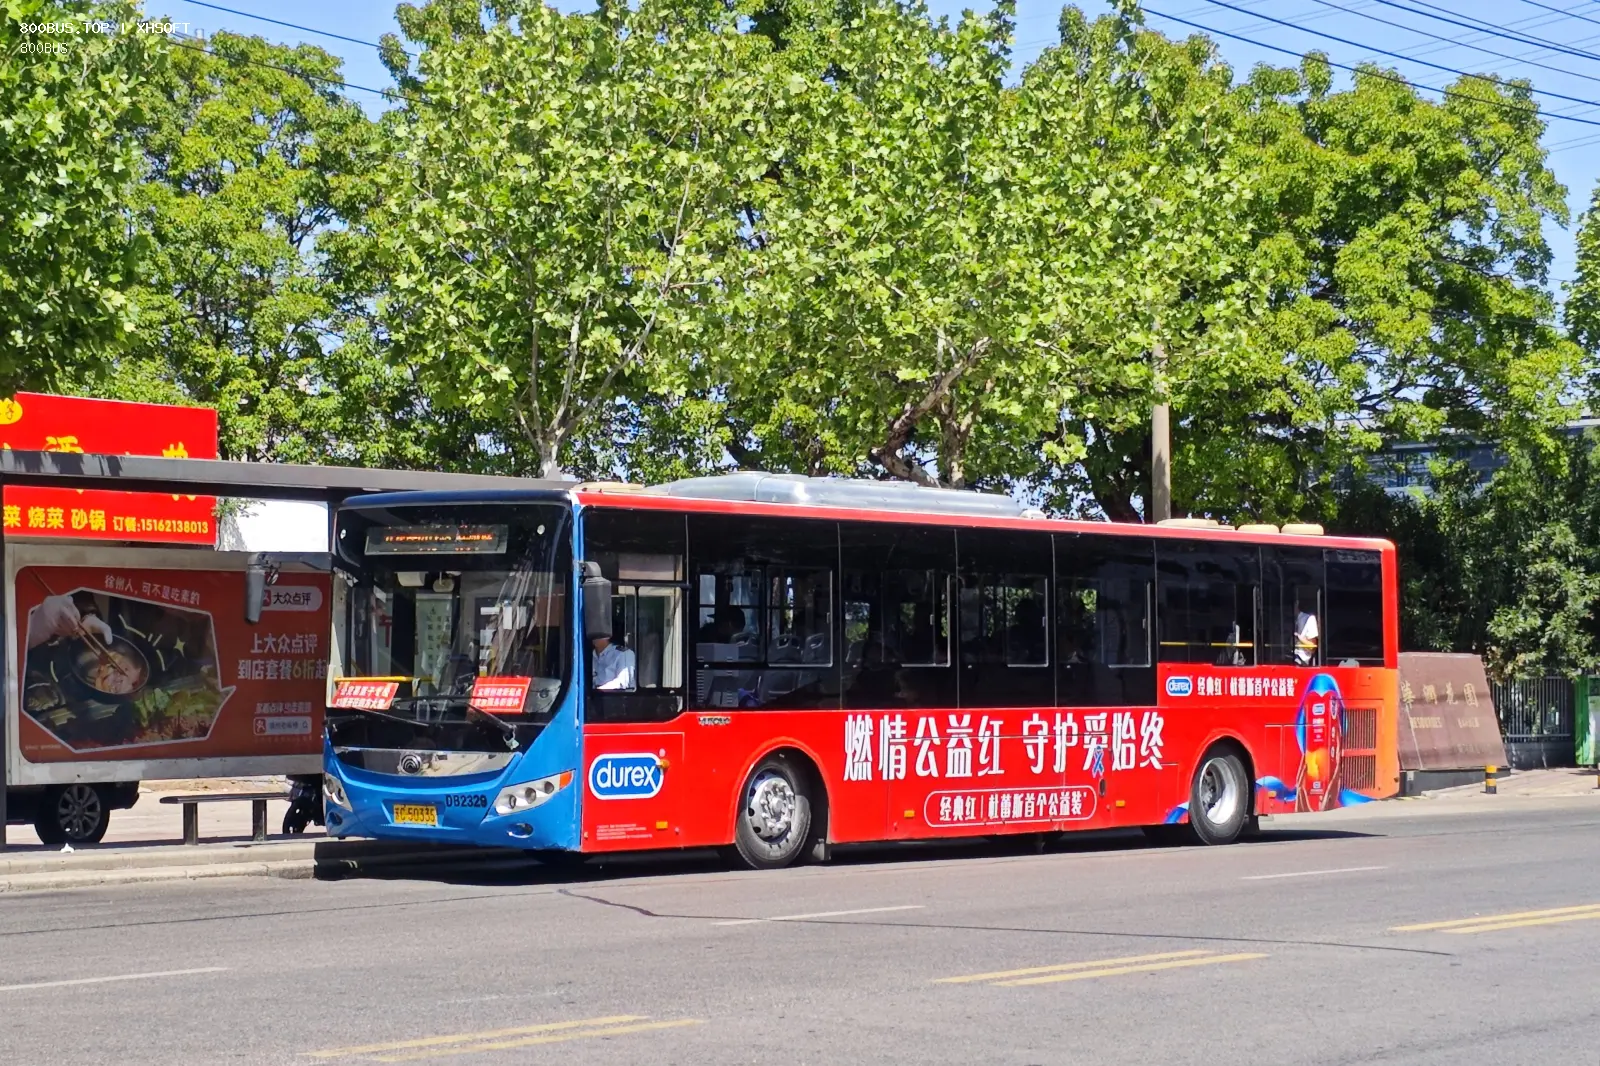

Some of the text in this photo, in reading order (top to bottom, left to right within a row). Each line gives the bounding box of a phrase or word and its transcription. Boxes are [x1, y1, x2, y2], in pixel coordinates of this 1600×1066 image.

[28, 506, 64, 530] 烧菜
[71, 508, 106, 531] 砂锅
[273, 592, 312, 606] 大众点评
[250, 632, 319, 654] 上大众点评
[237, 659, 328, 680] 到店套餐6折起
[843, 711, 1165, 782] 燃情公益红 守护爱始终
[596, 760, 657, 791] durex
[939, 792, 1083, 821] 经典红 杜蕾斯首个公益装
